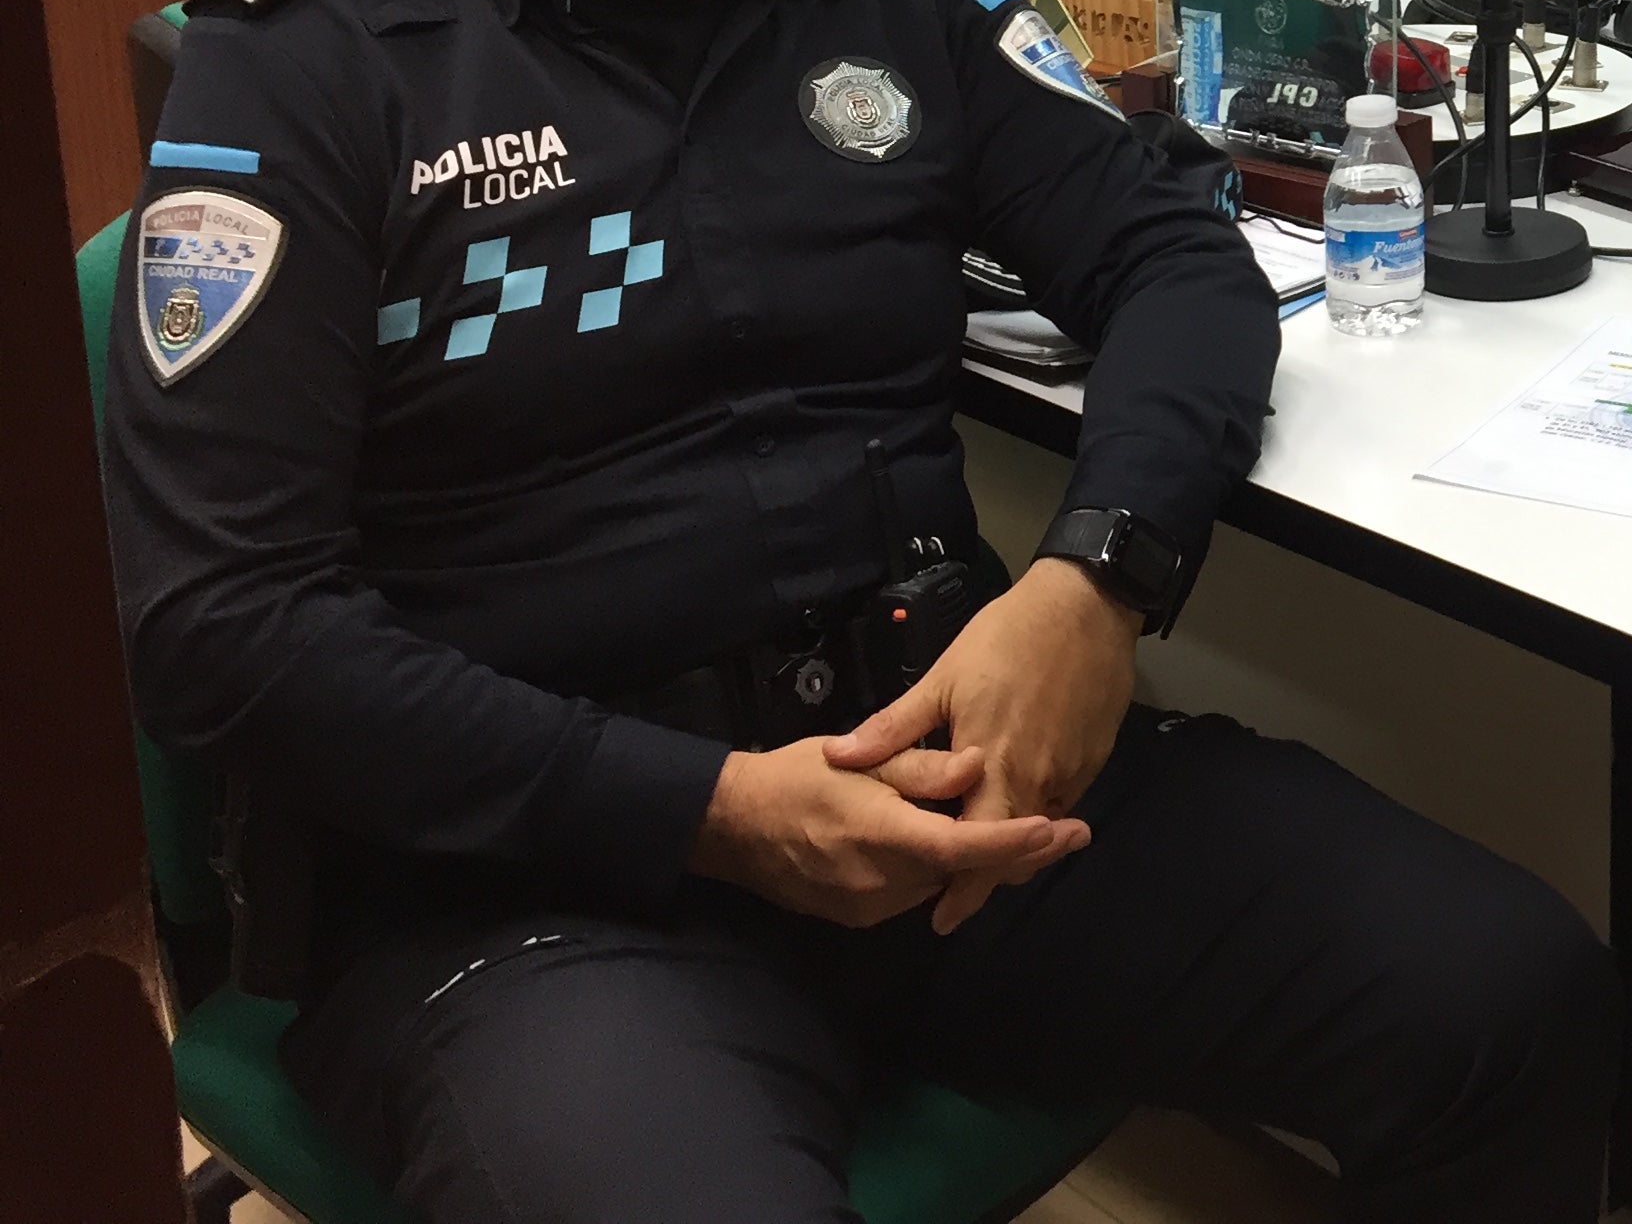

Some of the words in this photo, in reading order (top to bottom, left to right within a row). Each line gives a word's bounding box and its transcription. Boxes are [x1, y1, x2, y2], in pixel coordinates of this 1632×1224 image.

[411, 126, 568, 195] POLICIA
[464, 160, 576, 210] LOCAL
[152, 207, 200, 229] POLICIA
[205, 213, 250, 235] LOCAL
[148, 265, 194, 279] CIUDAD
[198, 268, 239, 283] REAL
